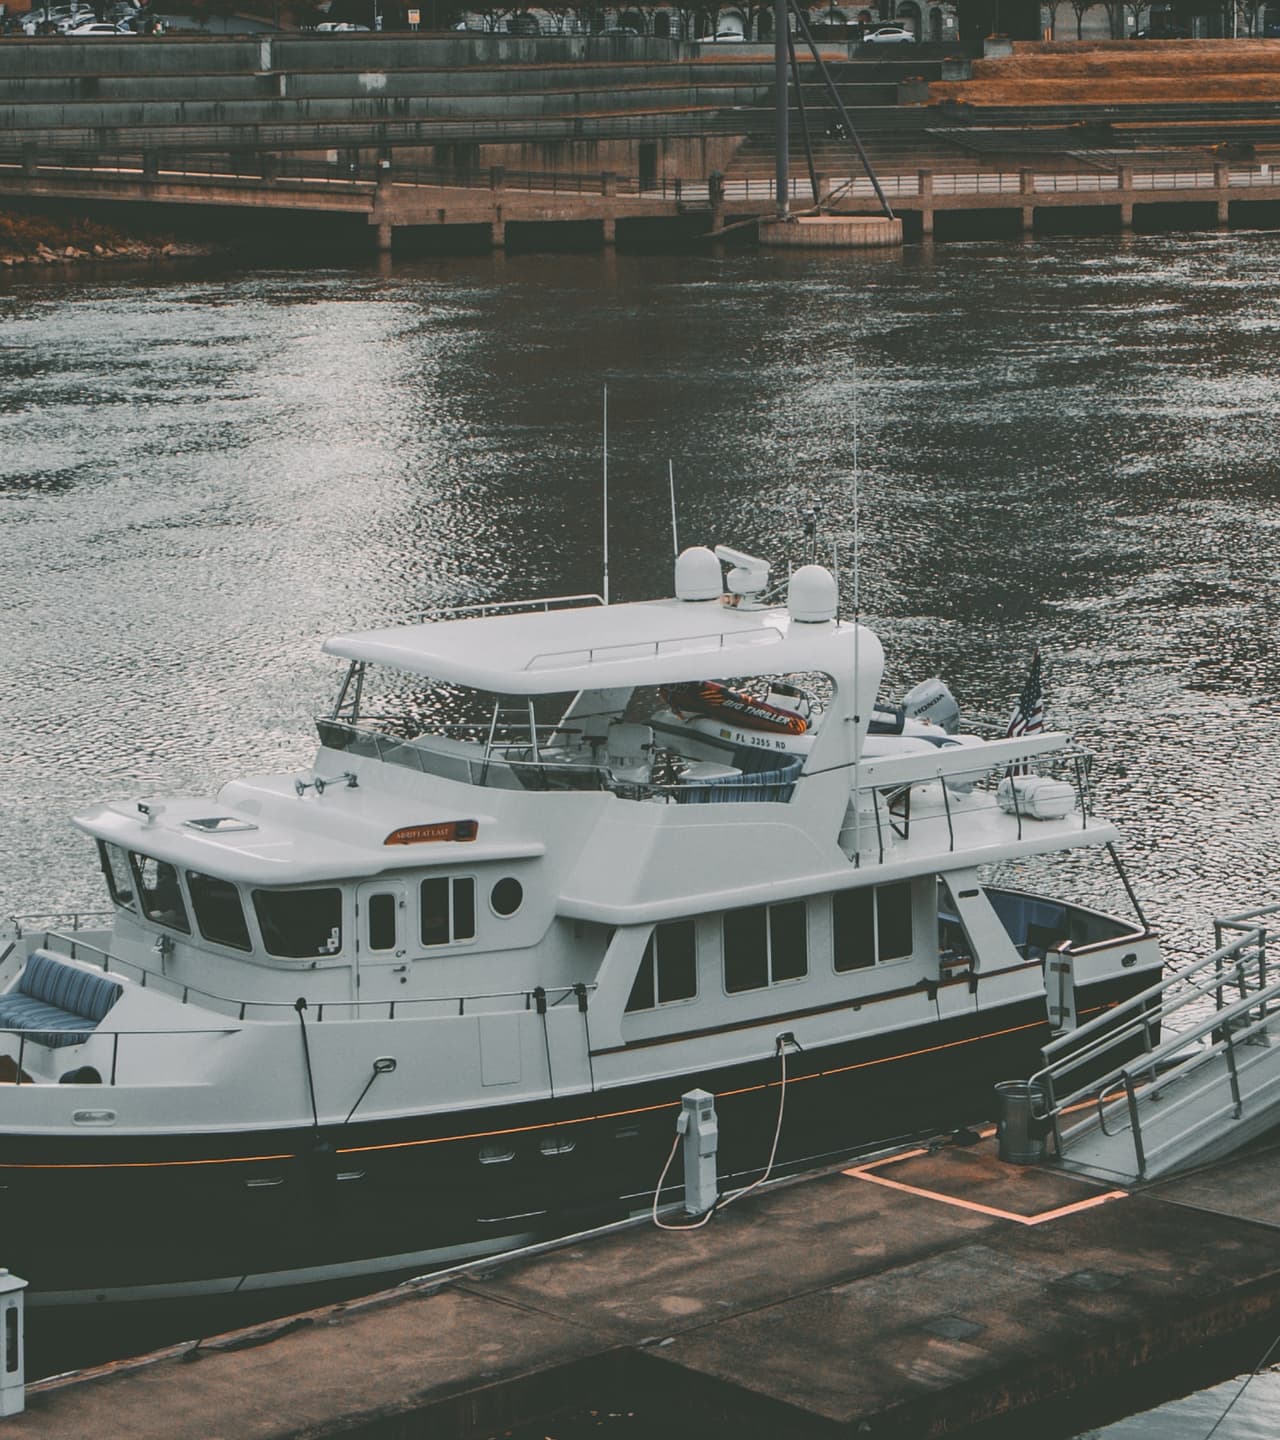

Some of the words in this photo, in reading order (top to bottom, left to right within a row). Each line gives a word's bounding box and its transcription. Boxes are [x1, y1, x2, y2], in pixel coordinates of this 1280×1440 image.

[913, 693, 946, 716] HONDA
[744, 705, 791, 725] THRILLER
[735, 732, 745, 743] FL
